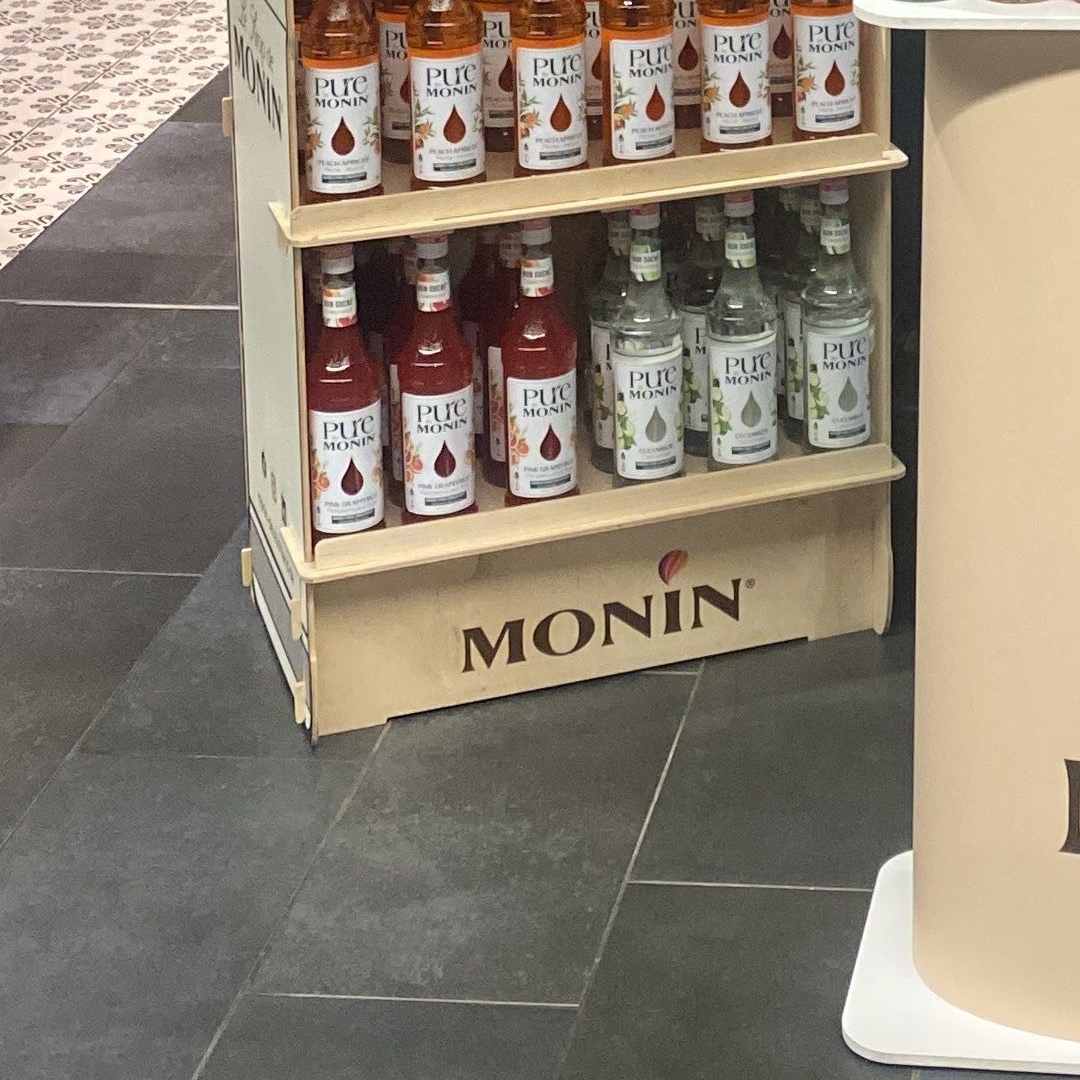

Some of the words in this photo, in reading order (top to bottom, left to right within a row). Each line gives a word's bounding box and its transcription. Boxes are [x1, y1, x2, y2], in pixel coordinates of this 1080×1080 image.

[809, 40, 855, 53] MONIN
[713, 51, 762, 64] MONIN
[533, 73, 582, 87] MONIN
[426, 84, 477, 98] MONIN
[315, 97, 368, 109] MONIN
[823, 356, 867, 370] MONIN
[725, 371, 772, 385] MONIN
[629, 385, 677, 400] MONIN
[523, 403, 572, 418] MONIN
[417, 419, 467, 434] MONIN
[323, 435, 375, 451] MONIN
[462, 578, 742, 673] MONIN
